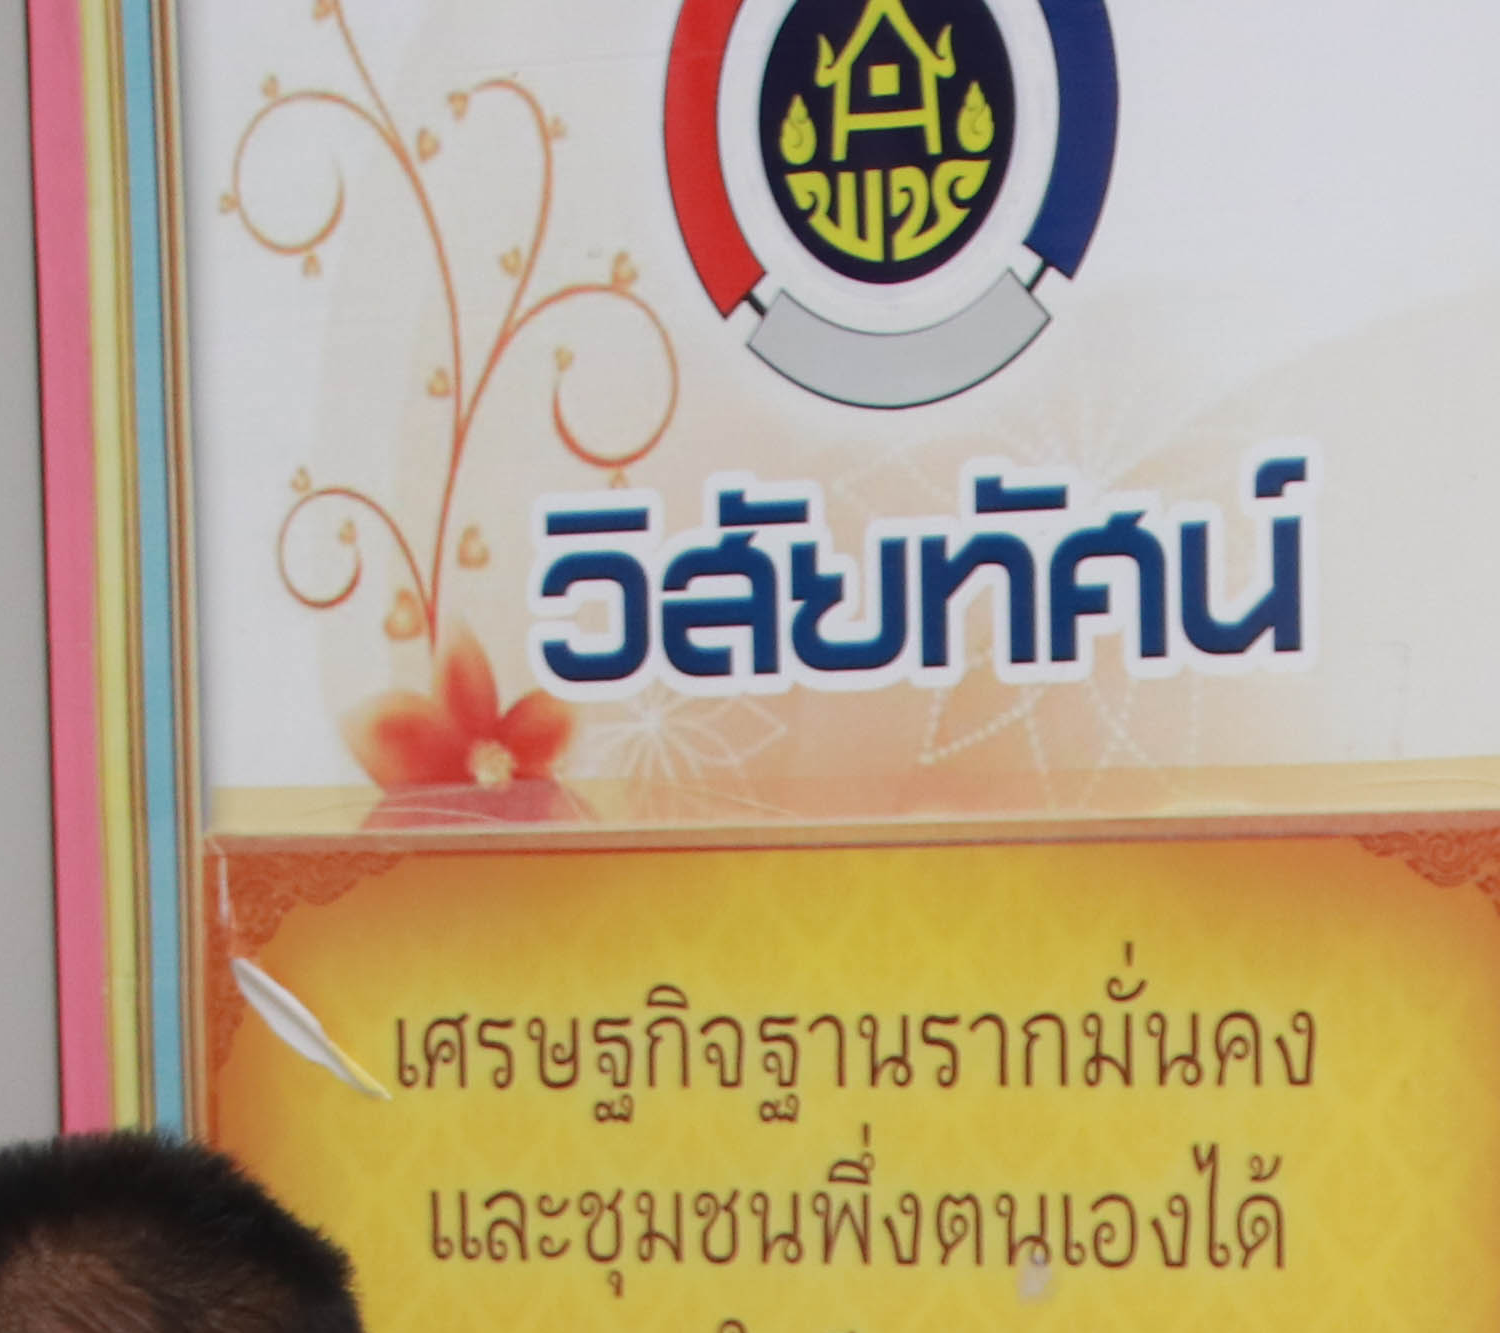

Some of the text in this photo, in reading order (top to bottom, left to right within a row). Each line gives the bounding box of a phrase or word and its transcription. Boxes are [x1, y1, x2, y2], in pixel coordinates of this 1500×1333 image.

[540, 455, 1308, 684] วิสัยทัศน์
[393, 938, 1318, 1124] เศรษฐกิจฐานรากมั่นคง
[429, 1122, 1287, 1299] และชุมชนพึ่งตนเองได้
